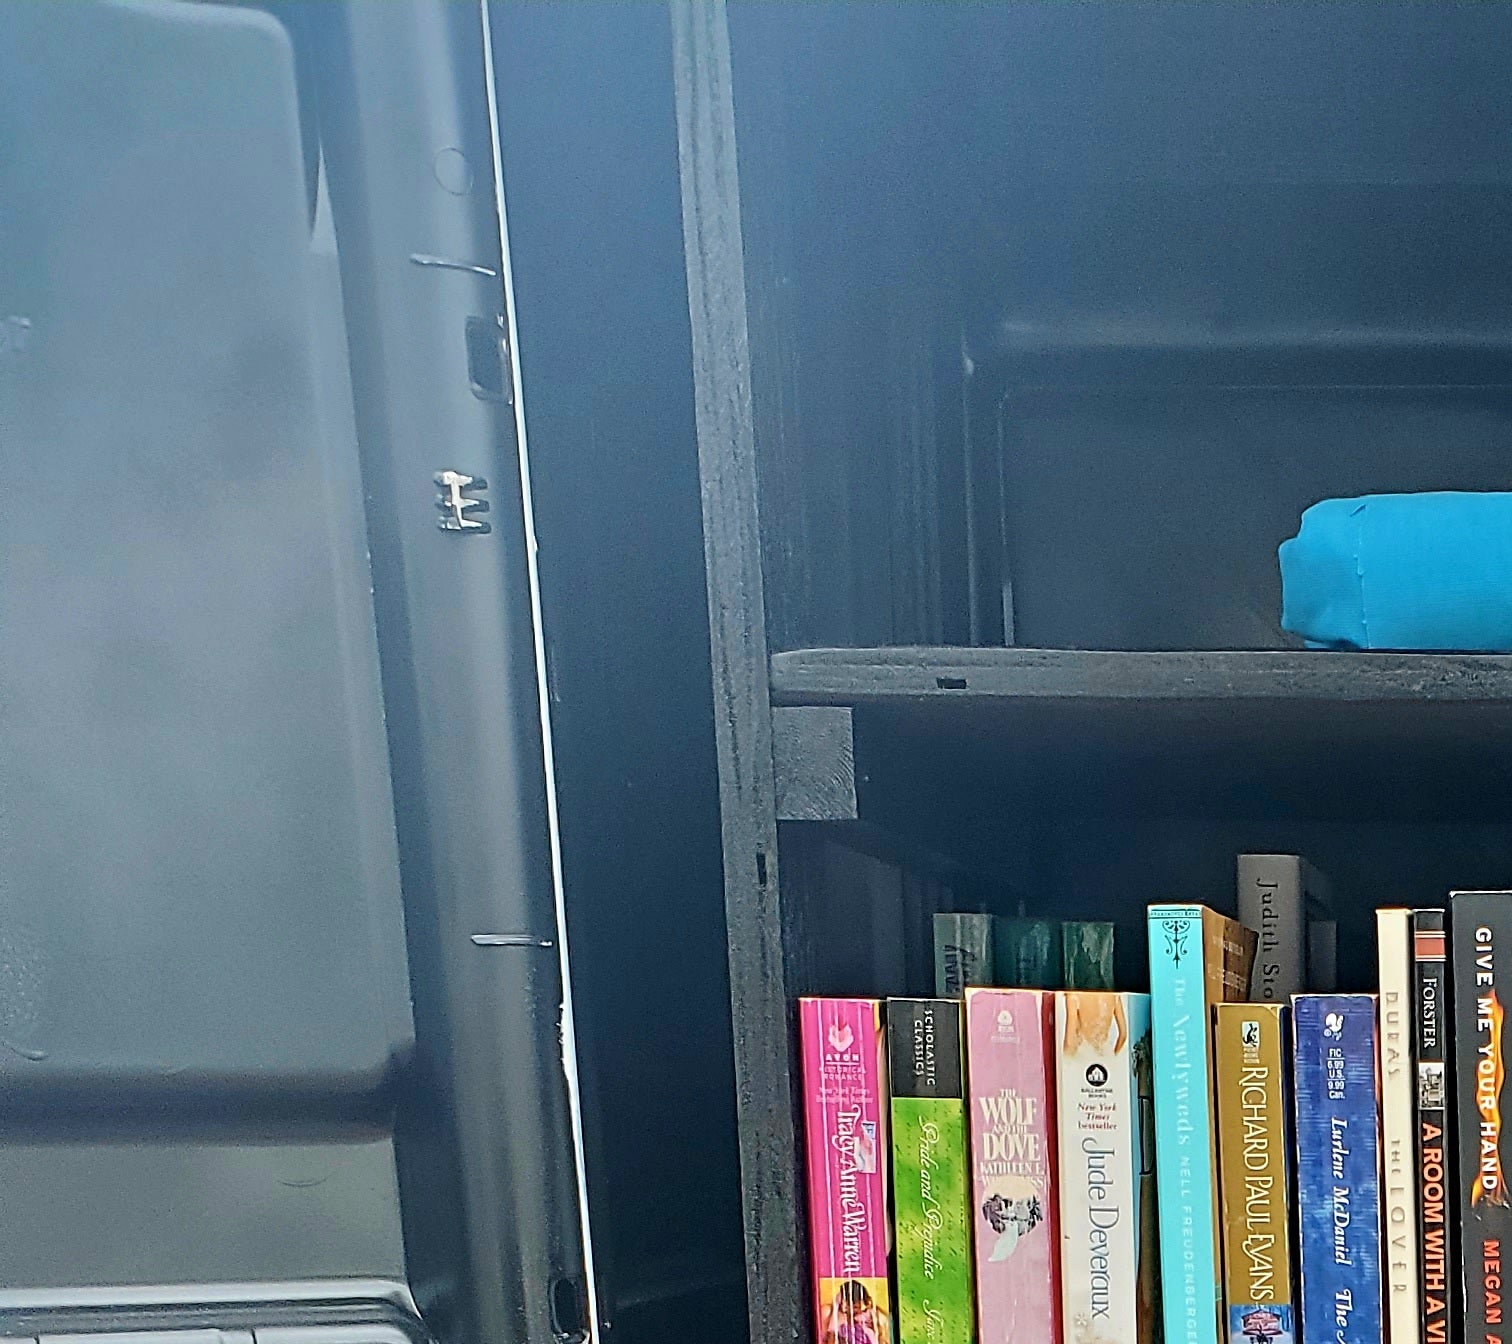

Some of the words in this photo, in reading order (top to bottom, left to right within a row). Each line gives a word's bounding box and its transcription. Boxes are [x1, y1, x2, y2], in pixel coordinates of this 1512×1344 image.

[1474, 926, 1494, 987] GIVE
[1422, 976, 1438, 1049] FORSTER
[1476, 998, 1493, 1033] ME
[914, 1019, 925, 1076] CLASSICS
[923, 1009, 936, 1087] SCHOLASTIC
[1477, 1045, 1497, 1110] YOUR
[979, 1097, 1038, 1126] WOLF
[1238, 1066, 1269, 1171] RICHARD
[1422, 1122, 1443, 1141] A
[982, 1133, 1040, 1162] DOVE
[1081, 1136, 1116, 1201] Jude
[1330, 1115, 1351, 1180] Lurlene
[1479, 1121, 1498, 1190] HAND
[1244, 1174, 1273, 1231] PAUL
[1422, 1147, 1444, 1224] ROOM
[1332, 1186, 1353, 1266] McDaniel
[1089, 1206, 1120, 1321] Deveraux
[1241, 1234, 1275, 1300] EVANS
[1424, 1228, 1446, 1292] WITH
[1482, 1239, 1501, 1325] MEGAN
[1335, 1288, 1353, 1328] The
[1426, 1302, 1447, 1316] A
